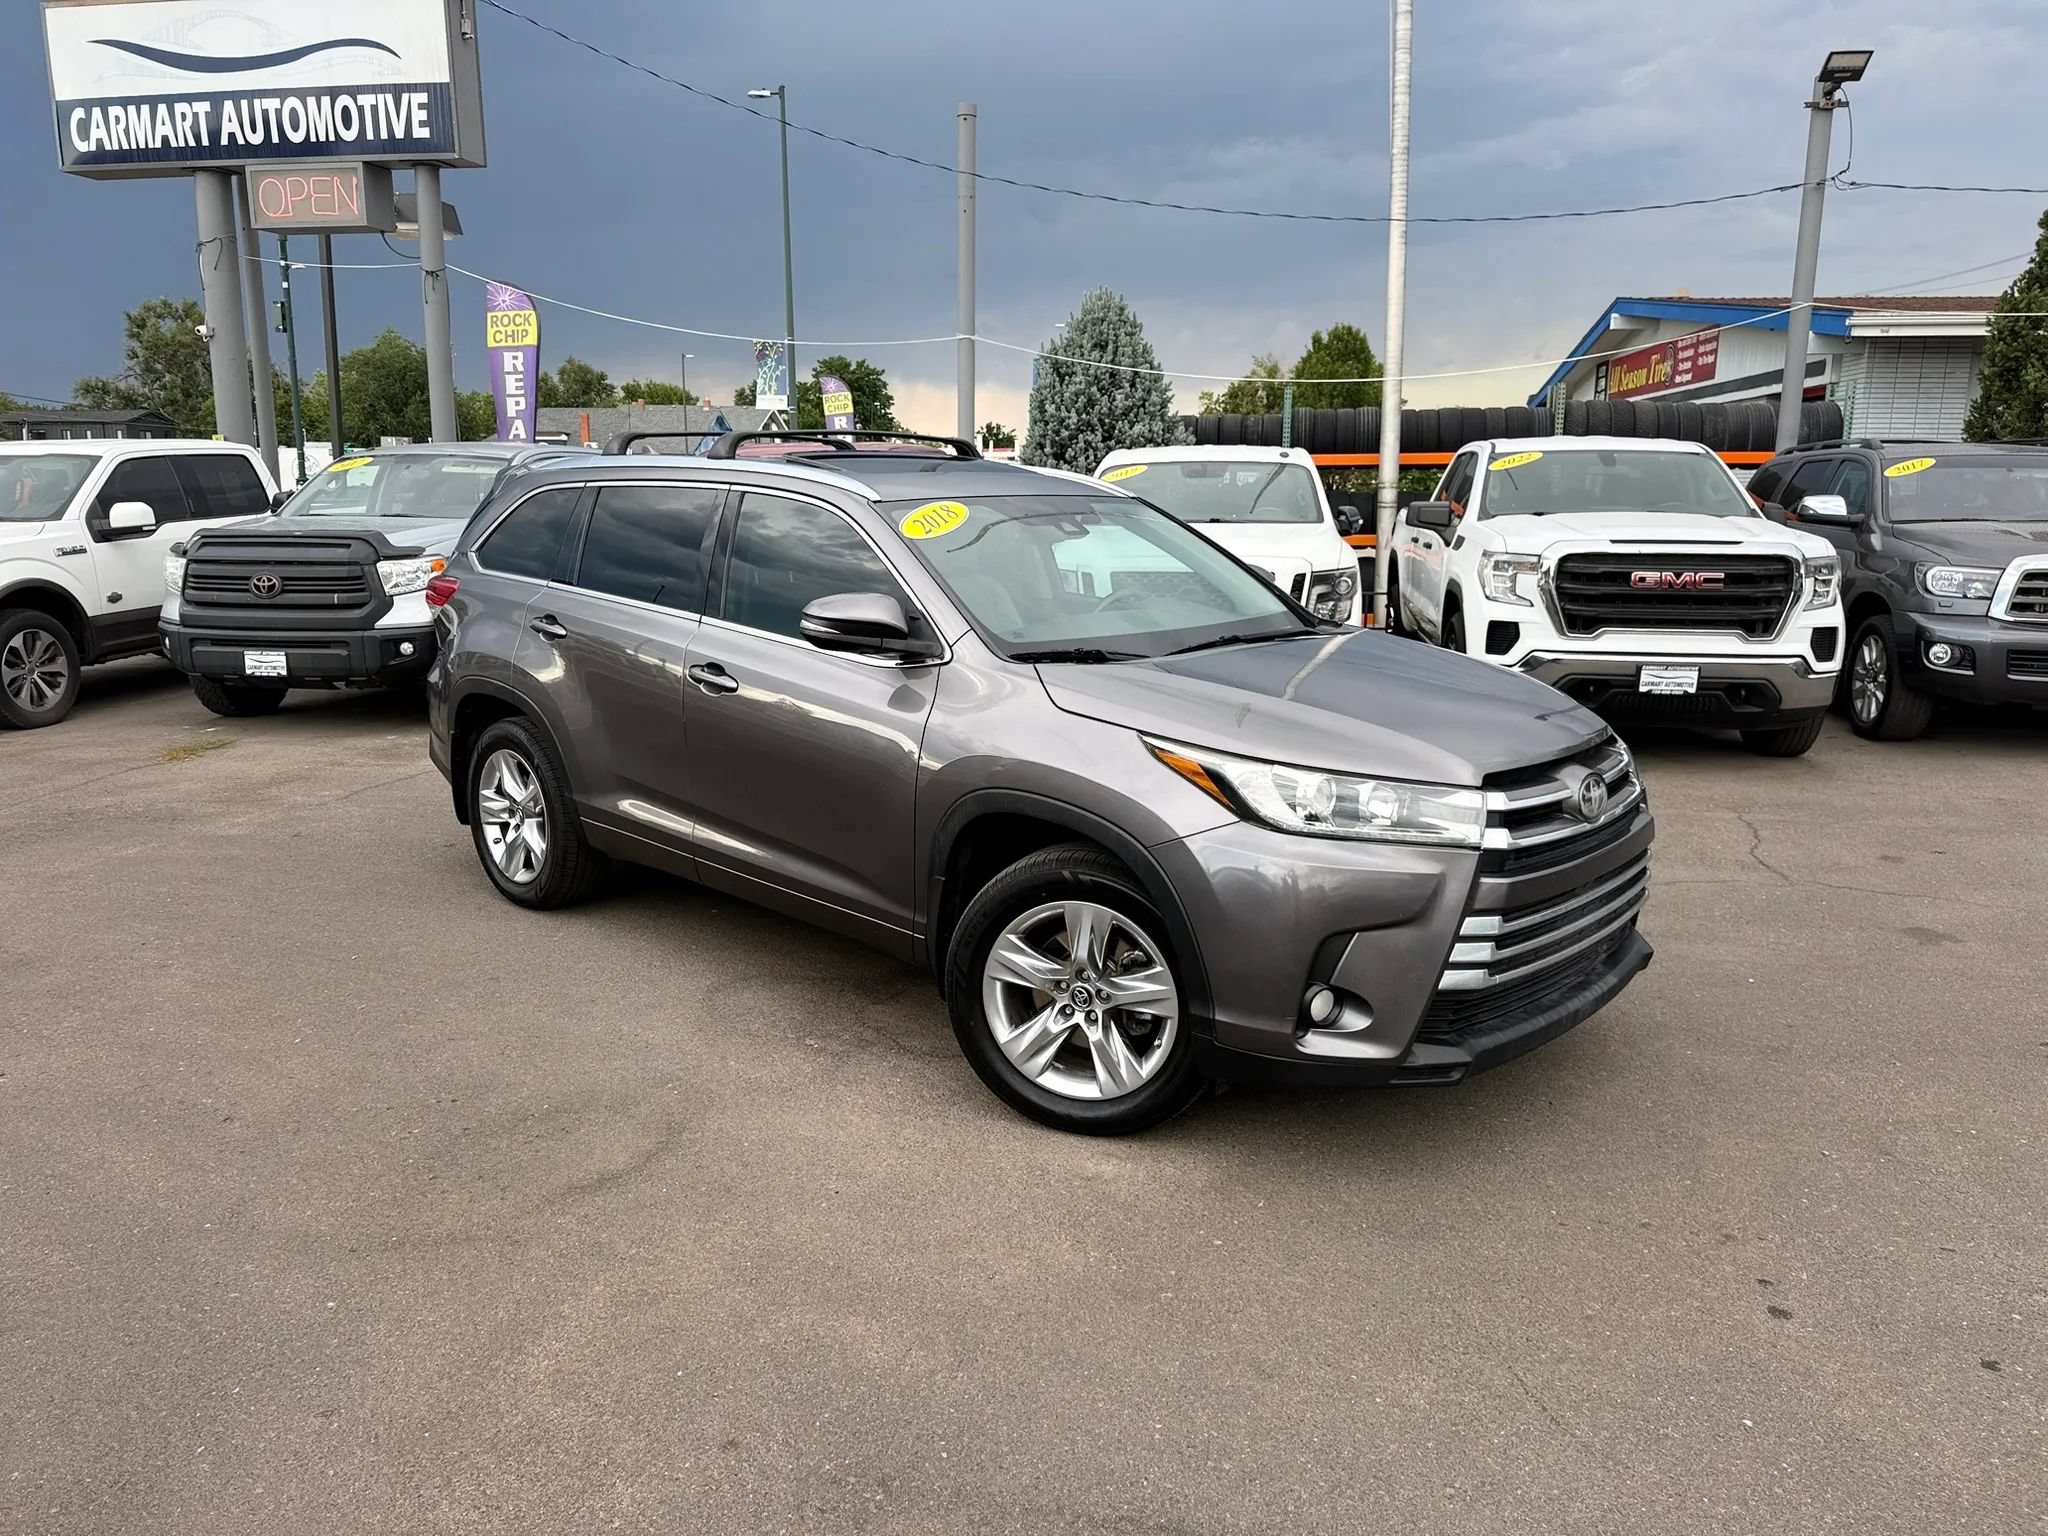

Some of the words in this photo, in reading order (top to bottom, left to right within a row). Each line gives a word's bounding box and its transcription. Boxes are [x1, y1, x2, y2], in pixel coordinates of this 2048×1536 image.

[70, 101, 211, 152] CARMART
[220, 92, 431, 147] AUTOMOTIVE
[258, 175, 360, 217] OPEN
[490, 313, 533, 329] ROCK
[492, 329, 529, 344] CHIP
[1619, 364, 1647, 391] Season
[824, 394, 851, 405] ROCK
[826, 403, 850, 413] CHIP
[1895, 459, 1924, 474] 2017
[912, 504, 959, 535] 2018
[1631, 571, 1725, 589] GMC
[1641, 680, 1664, 688] CARMART
